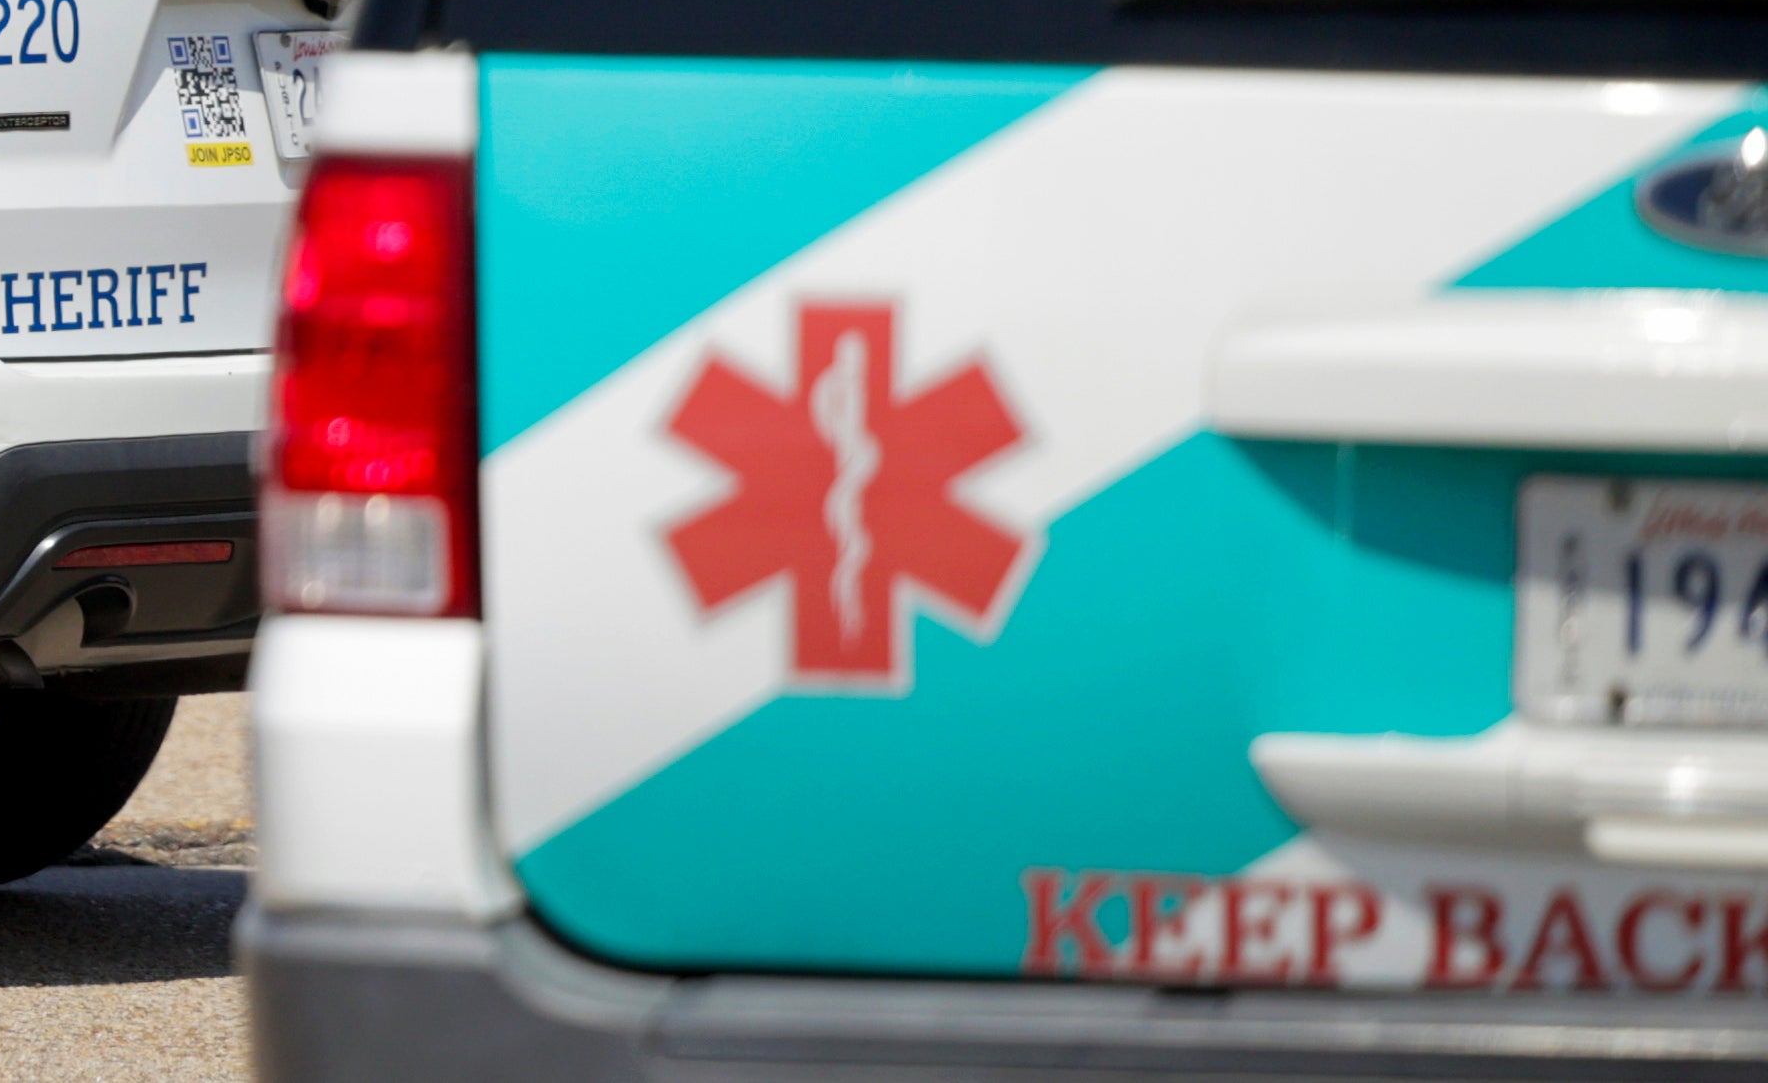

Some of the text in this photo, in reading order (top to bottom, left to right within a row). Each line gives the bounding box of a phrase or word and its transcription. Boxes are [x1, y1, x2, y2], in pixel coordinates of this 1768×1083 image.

[190, 146, 251, 163] JOIN JPSO
[1024, 870, 1383, 989] KEEP
